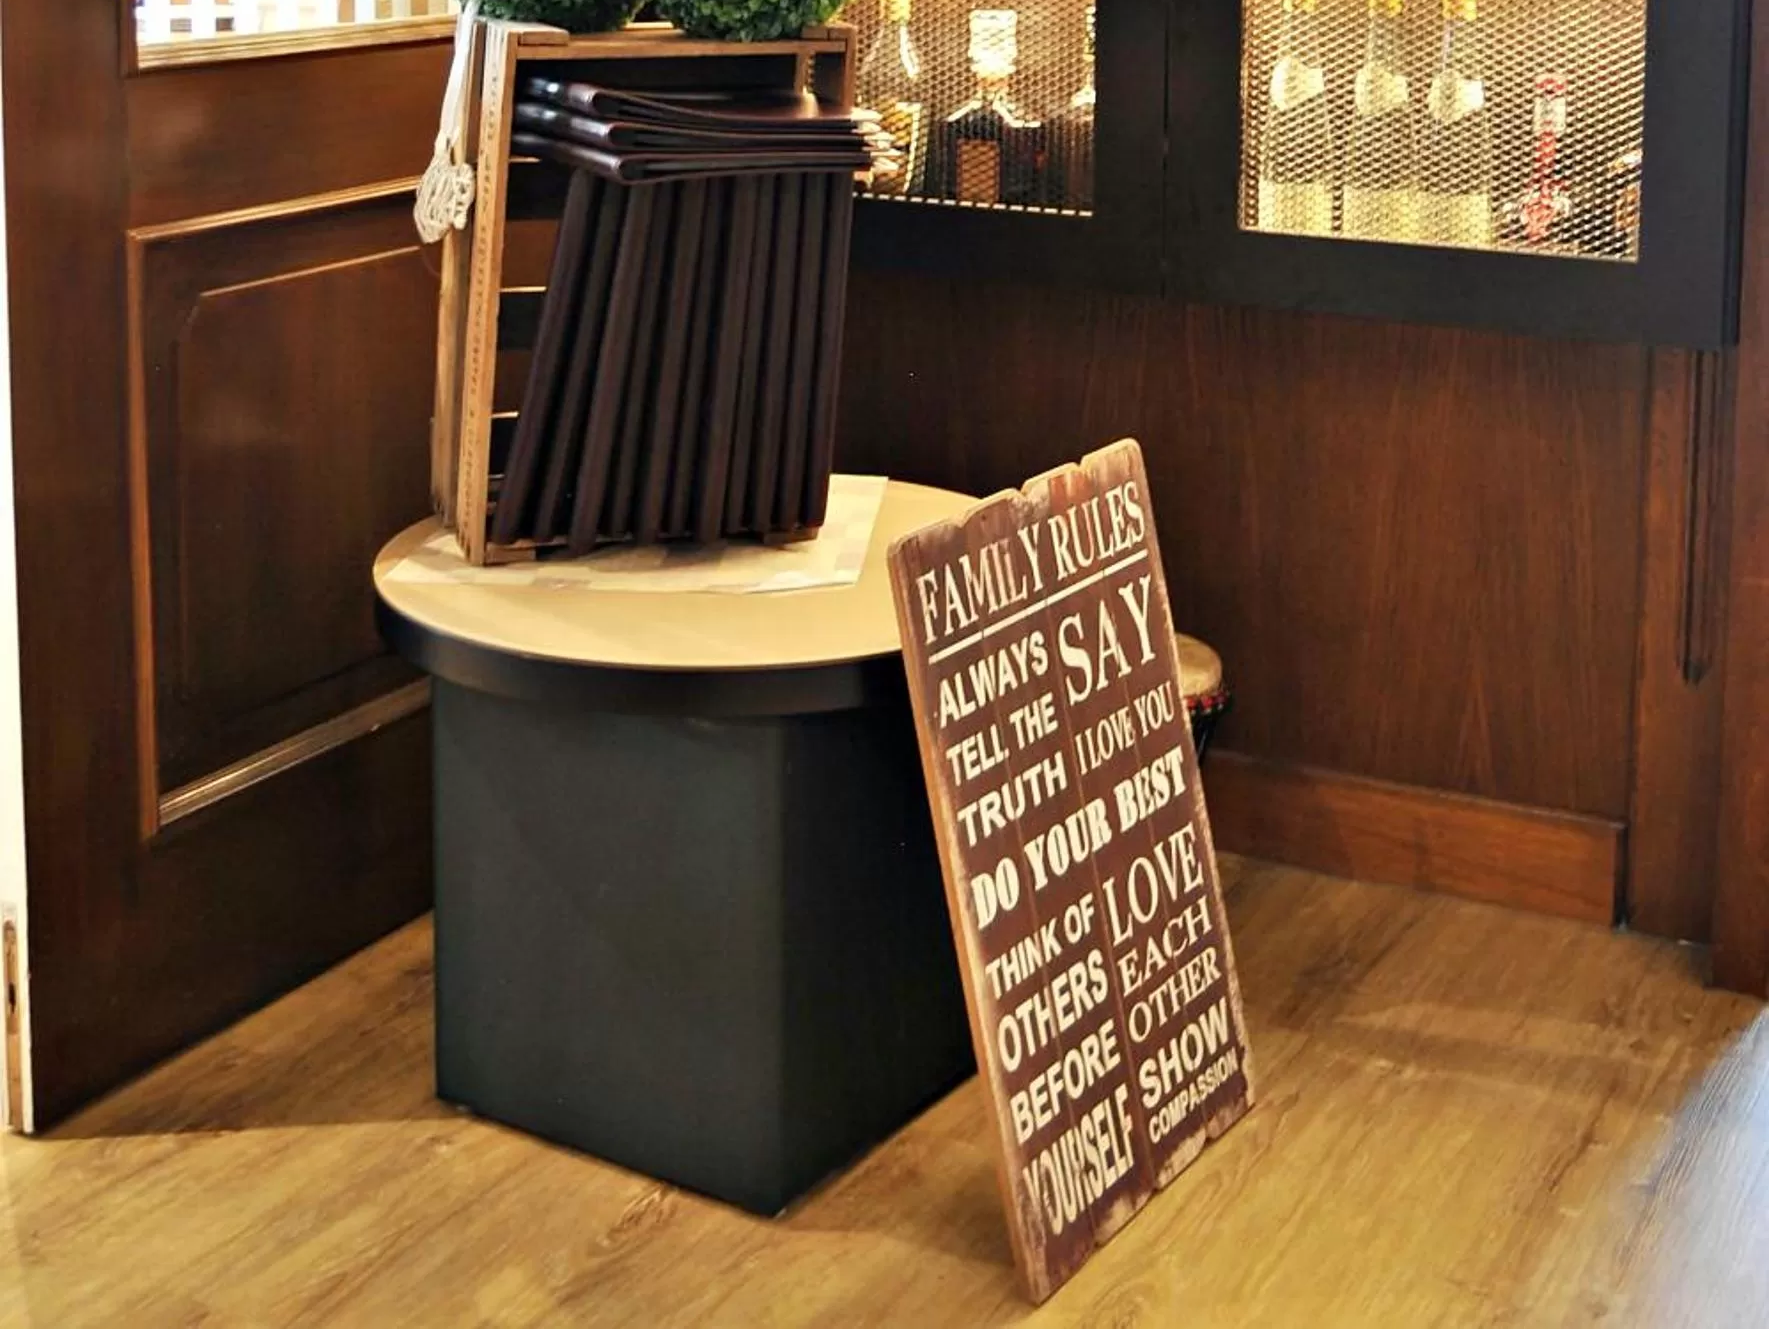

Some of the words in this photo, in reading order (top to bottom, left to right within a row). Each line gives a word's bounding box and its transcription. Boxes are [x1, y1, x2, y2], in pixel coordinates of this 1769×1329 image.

[916, 521, 1044, 644] FAMILY
[1048, 479, 1146, 580] RULES
[938, 630, 1050, 728] ALWAYS
[1057, 575, 1157, 706] SAY
[946, 724, 1009, 785] TELL
[1009, 692, 1059, 750] THE
[1075, 733, 1088, 775] I
[1087, 705, 1136, 764] LOVE
[1133, 680, 1176, 738] YOU
[957, 751, 1068, 847] TRUTH
[970, 857, 1021, 930] DO
[1023, 798, 1114, 892] YOUR
[1112, 745, 1189, 833] BEST
[1103, 824, 1206, 946] LOVE
[985, 928, 1063, 1000] THINK
[1064, 893, 1096, 943] OF
[1118, 895, 1214, 998] EACH
[1128, 946, 1223, 1043] OTHER
[997, 949, 1109, 1073] OTHERS
[1138, 998, 1231, 1110] SHOW
[1010, 1021, 1122, 1145] BEFORE
[1148, 1047, 1239, 1145] COMPASSION
[1022, 1083, 1135, 1236] YOURSELF
